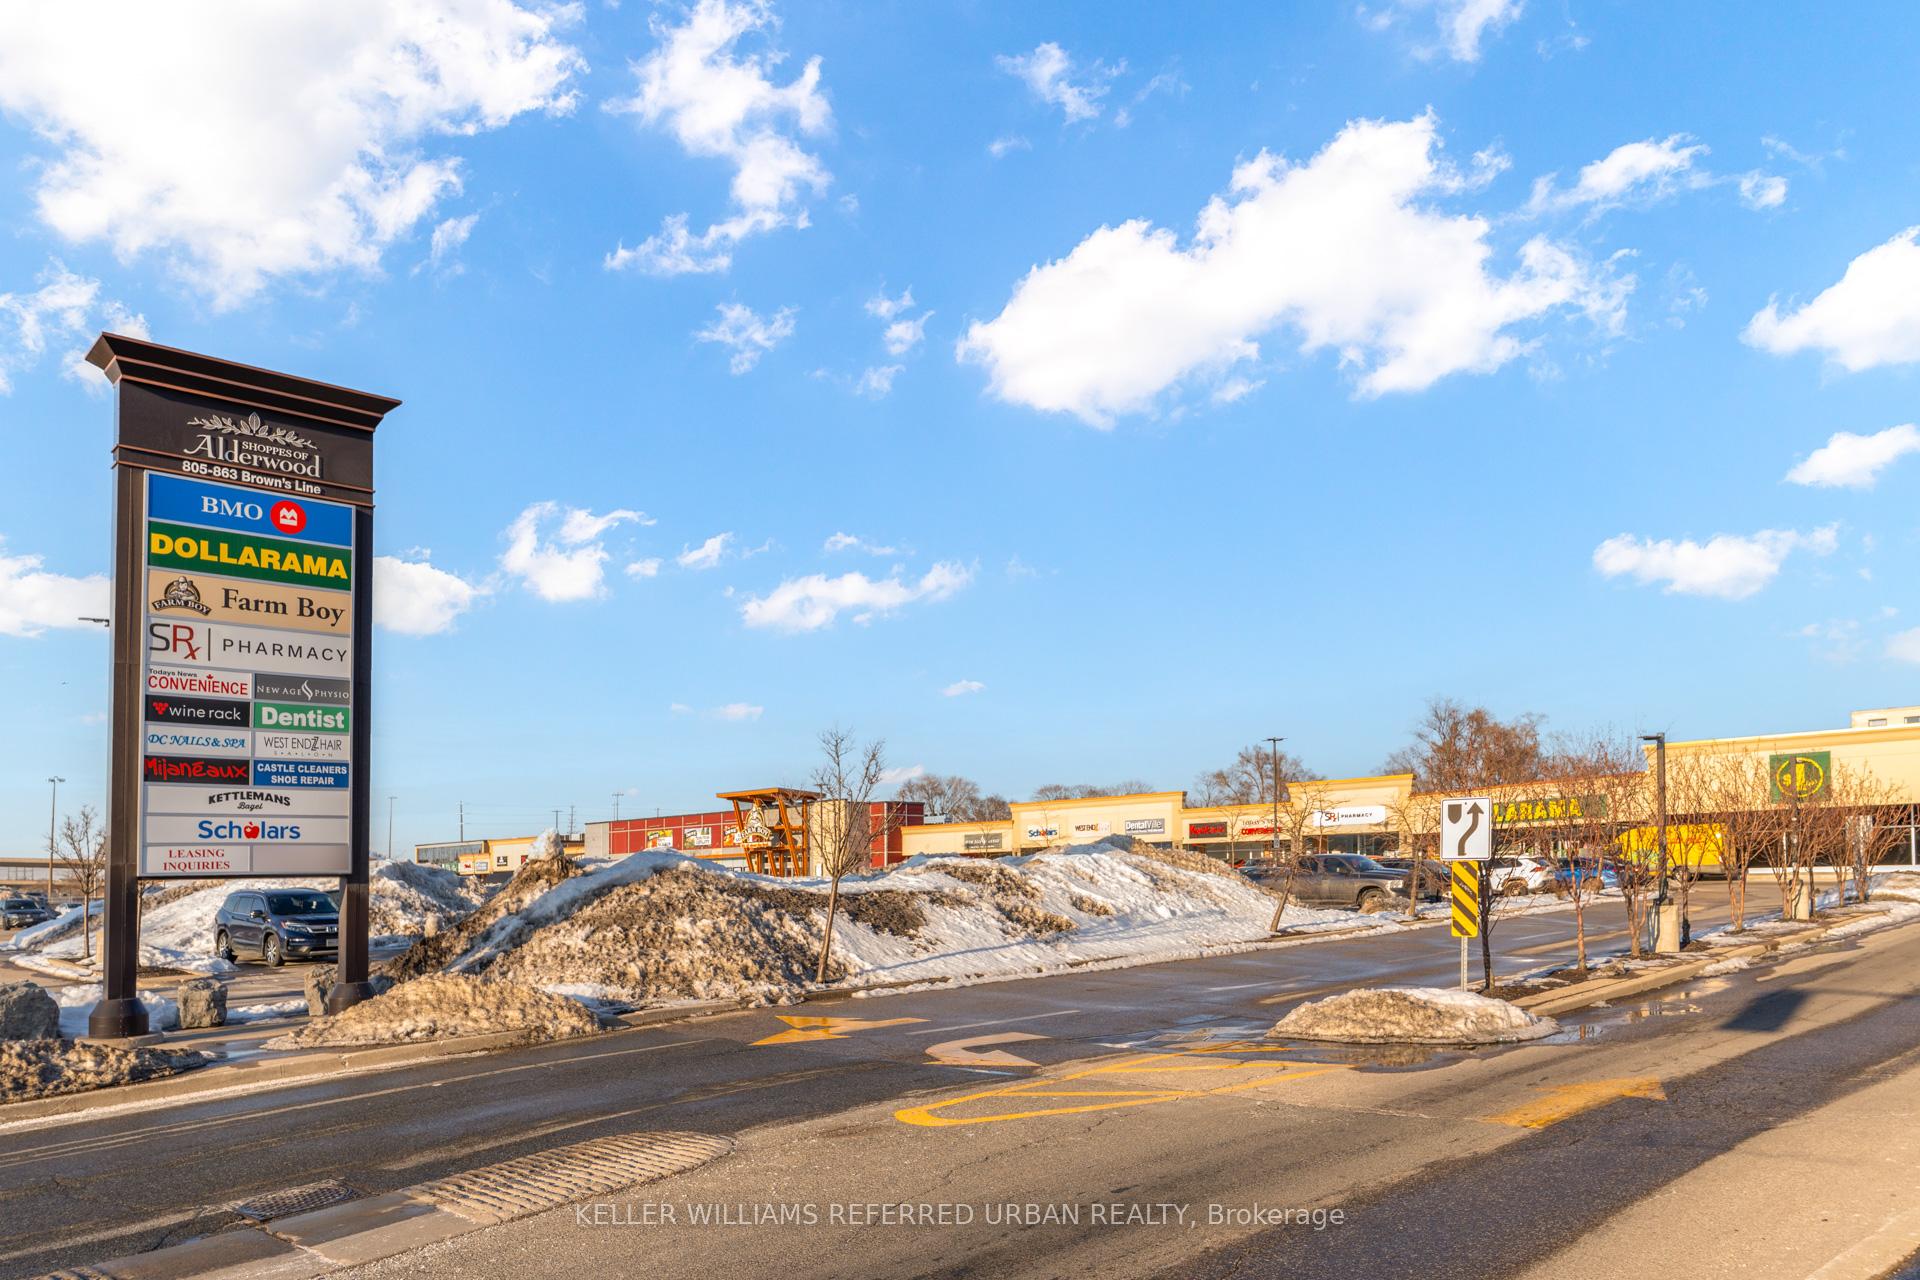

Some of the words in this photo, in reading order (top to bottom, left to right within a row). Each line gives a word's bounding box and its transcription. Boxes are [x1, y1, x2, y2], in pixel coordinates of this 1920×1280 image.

[183, 434, 321, 478] Alderwood
[241, 441, 292, 457] SHOPPES
[293, 451, 309, 461] OF
[182, 460, 238, 480] 805-863
[241, 470, 292, 490] Brown's
[294, 479, 321, 495] Line
[200, 495, 263, 521] BMO
[150, 532, 348, 580] DOLLARAMA
[153, 599, 185, 611] FARM
[187, 600, 210, 614] BOY
[222, 587, 288, 615] Farm
[296, 597, 345, 626] Boy
[223, 638, 347, 662] PHARMACY
[149, 668, 176, 678] Todays
[177, 670, 198, 678] News
[148, 675, 248, 696] CONVENIENCE
[256, 685, 280, 694] NEW
[282, 687, 302, 696] AGE
[314, 689, 350, 700] PHYSIO
[169, 704, 206, 718] wine
[208, 706, 241, 721] rack
[261, 706, 345, 729] Dentist
[148, 734, 168, 745] DC
[222, 738, 246, 749] SPA
[264, 736, 289, 749] WEST
[320, 739, 342, 751] HAIR
[257, 763, 295, 773] CASTLE
[297, 764, 348, 775] CLEANERS
[271, 775, 298, 784] SHOE
[300, 776, 335, 785] REPAIR
[208, 791, 291, 806] KETTLEMANS
[237, 801, 263, 811] Bagel
[198, 820, 301, 839] Scholars
[168, 848, 225, 859] LEASING
[162, 860, 230, 872] INQUIRIES
